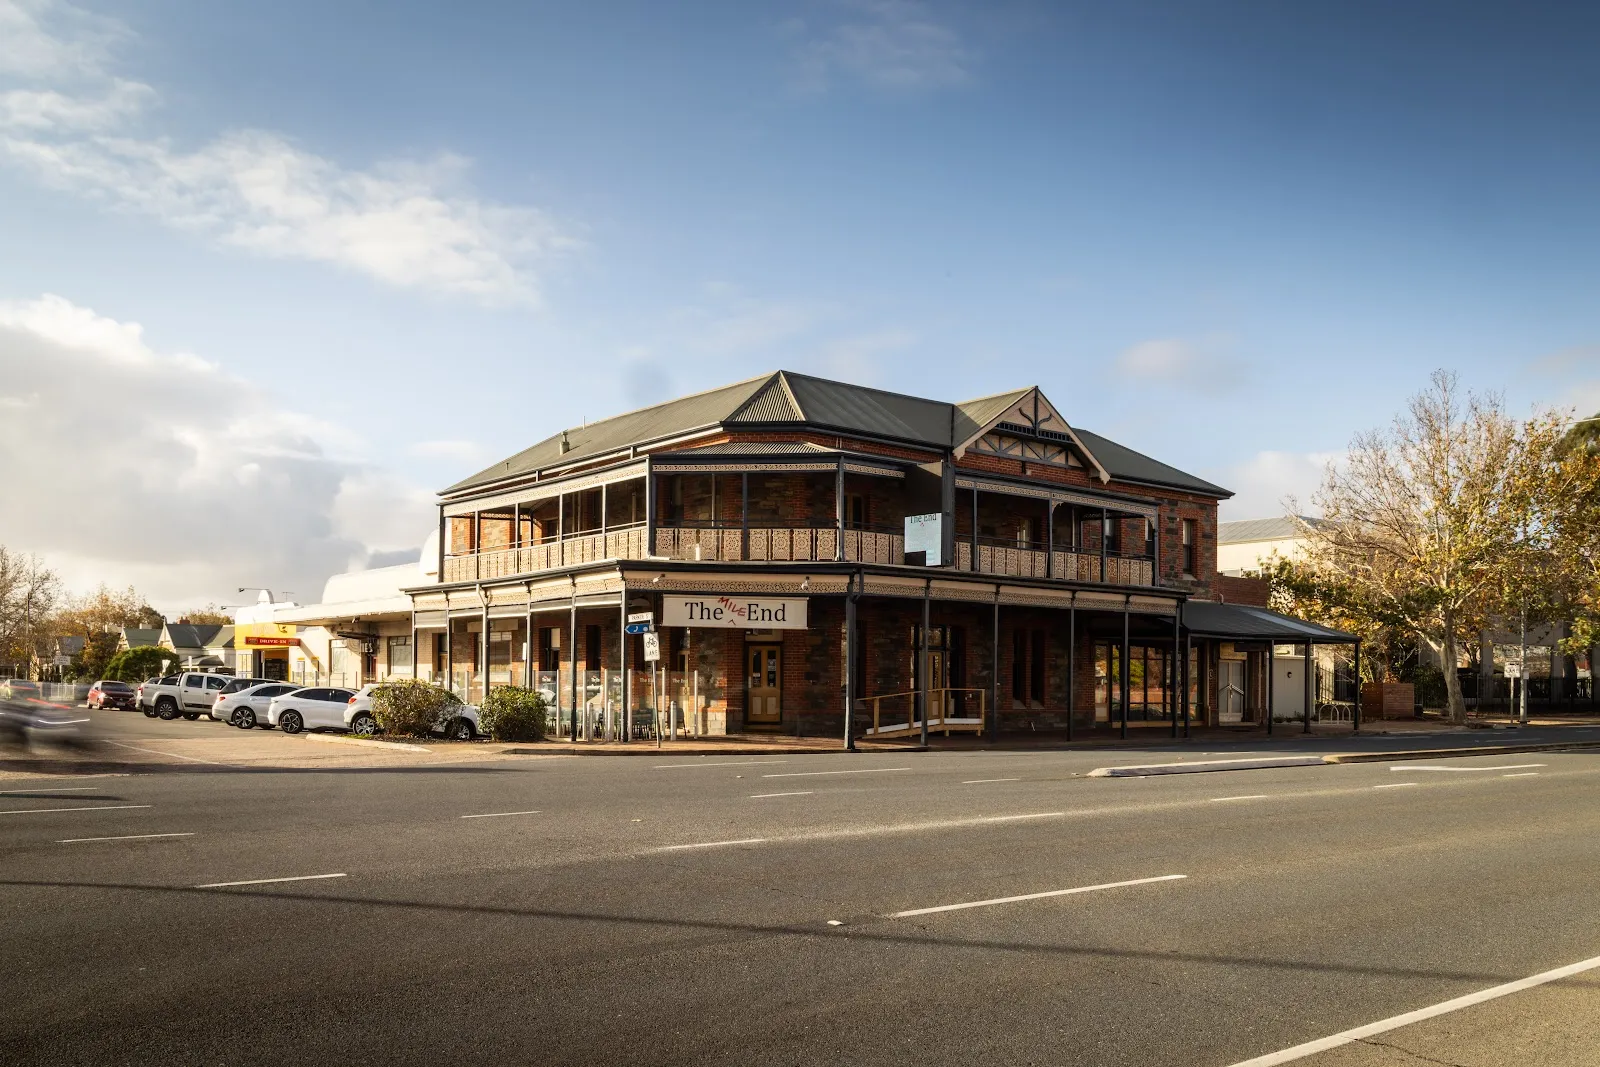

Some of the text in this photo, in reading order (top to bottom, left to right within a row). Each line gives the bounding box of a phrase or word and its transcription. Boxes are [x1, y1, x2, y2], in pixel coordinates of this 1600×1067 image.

[685, 596, 787, 621] The MILE End
